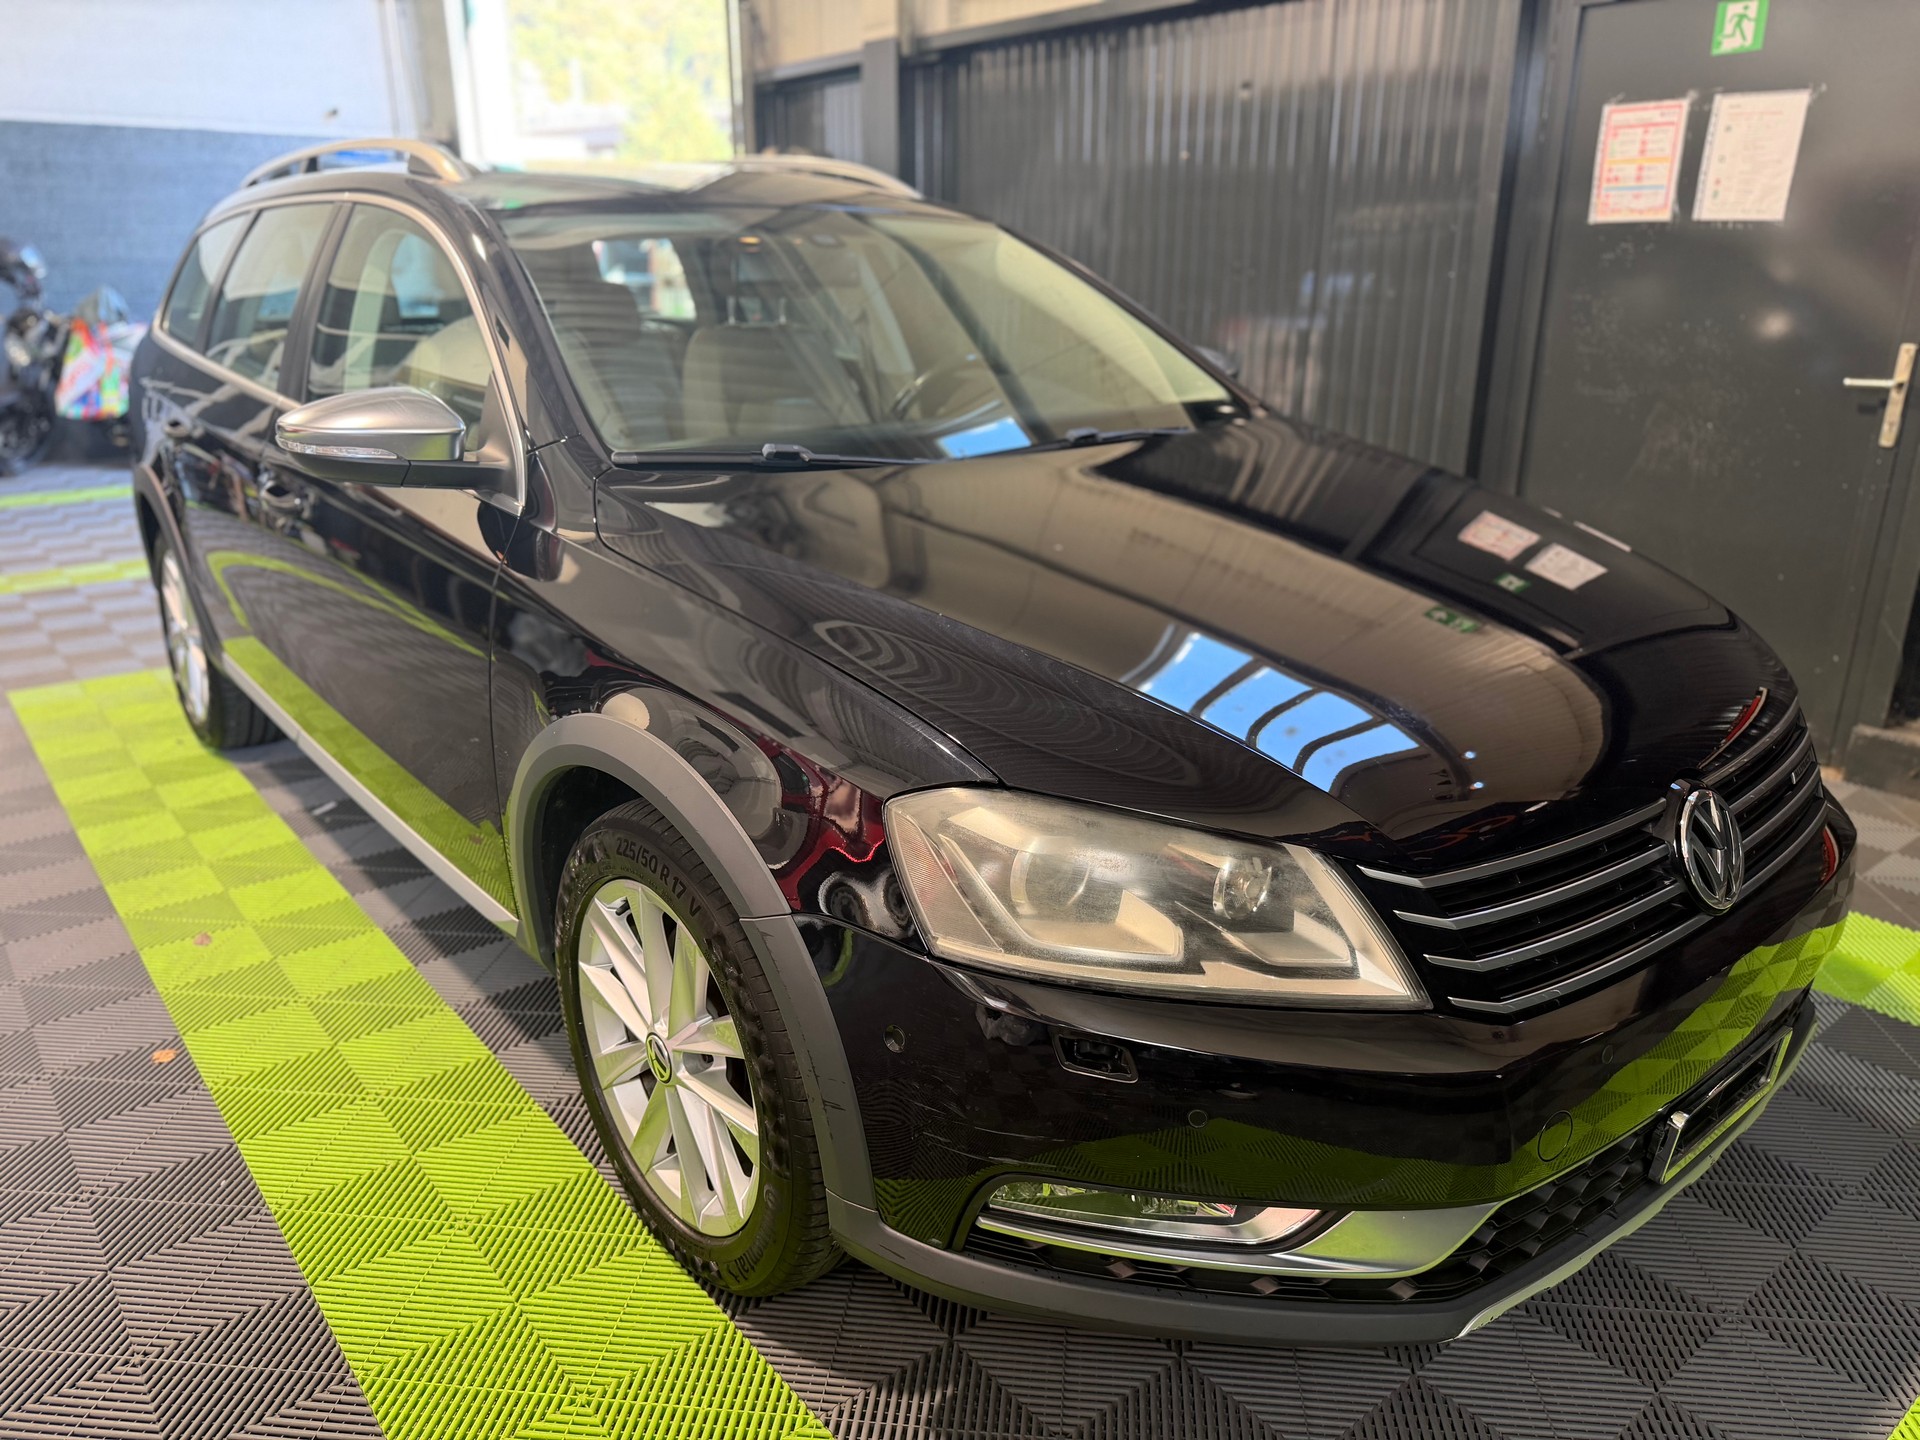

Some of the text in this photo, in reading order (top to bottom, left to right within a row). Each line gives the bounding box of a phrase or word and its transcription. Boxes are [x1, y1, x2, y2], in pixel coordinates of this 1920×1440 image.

[616, 837, 658, 874] 225/50
[660, 863, 670, 886] R
[671, 876, 687, 899] 17
[689, 896, 702, 917] V
[734, 1184, 777, 1281] Cotinental
